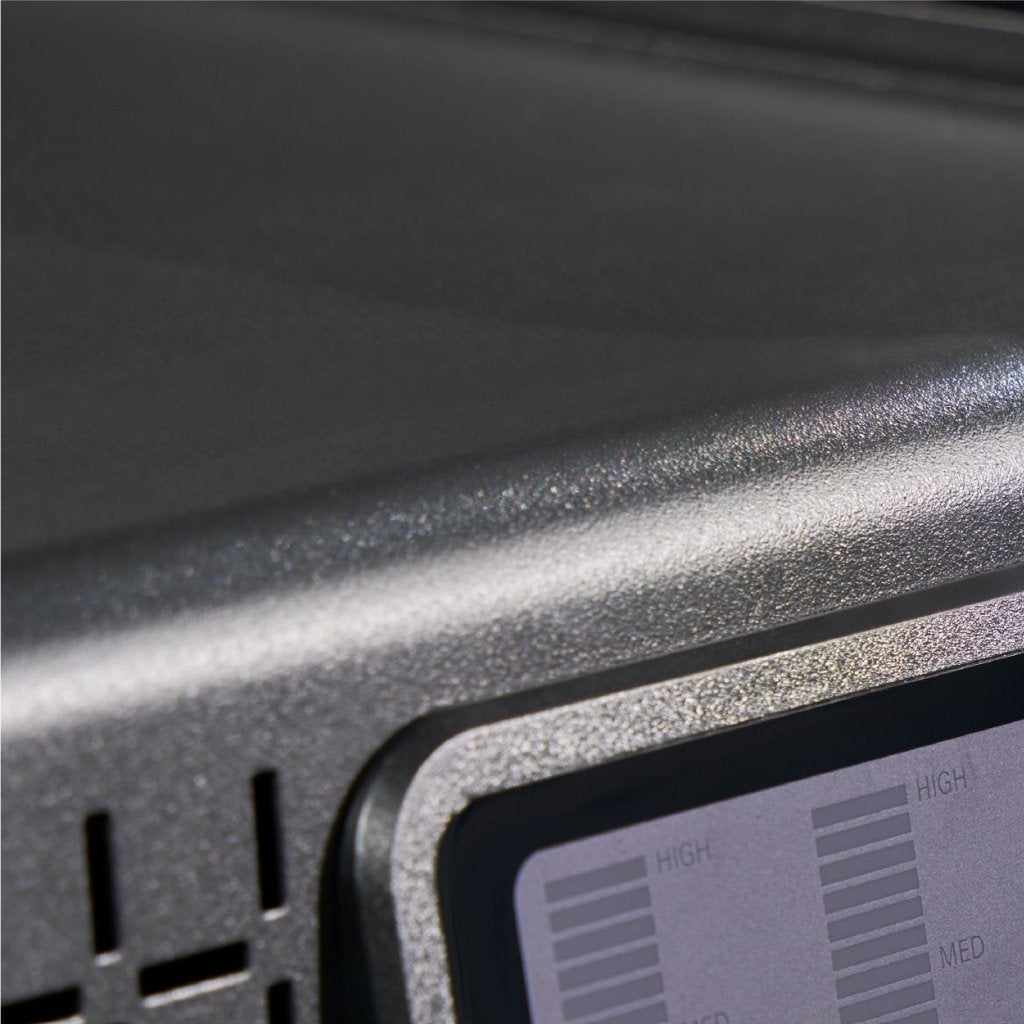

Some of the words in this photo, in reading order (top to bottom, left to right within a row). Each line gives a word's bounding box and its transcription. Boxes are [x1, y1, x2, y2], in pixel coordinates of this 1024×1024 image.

[916, 766, 968, 801] HIGH
[655, 839, 713, 873] HIGH
[939, 935, 986, 970] MED
